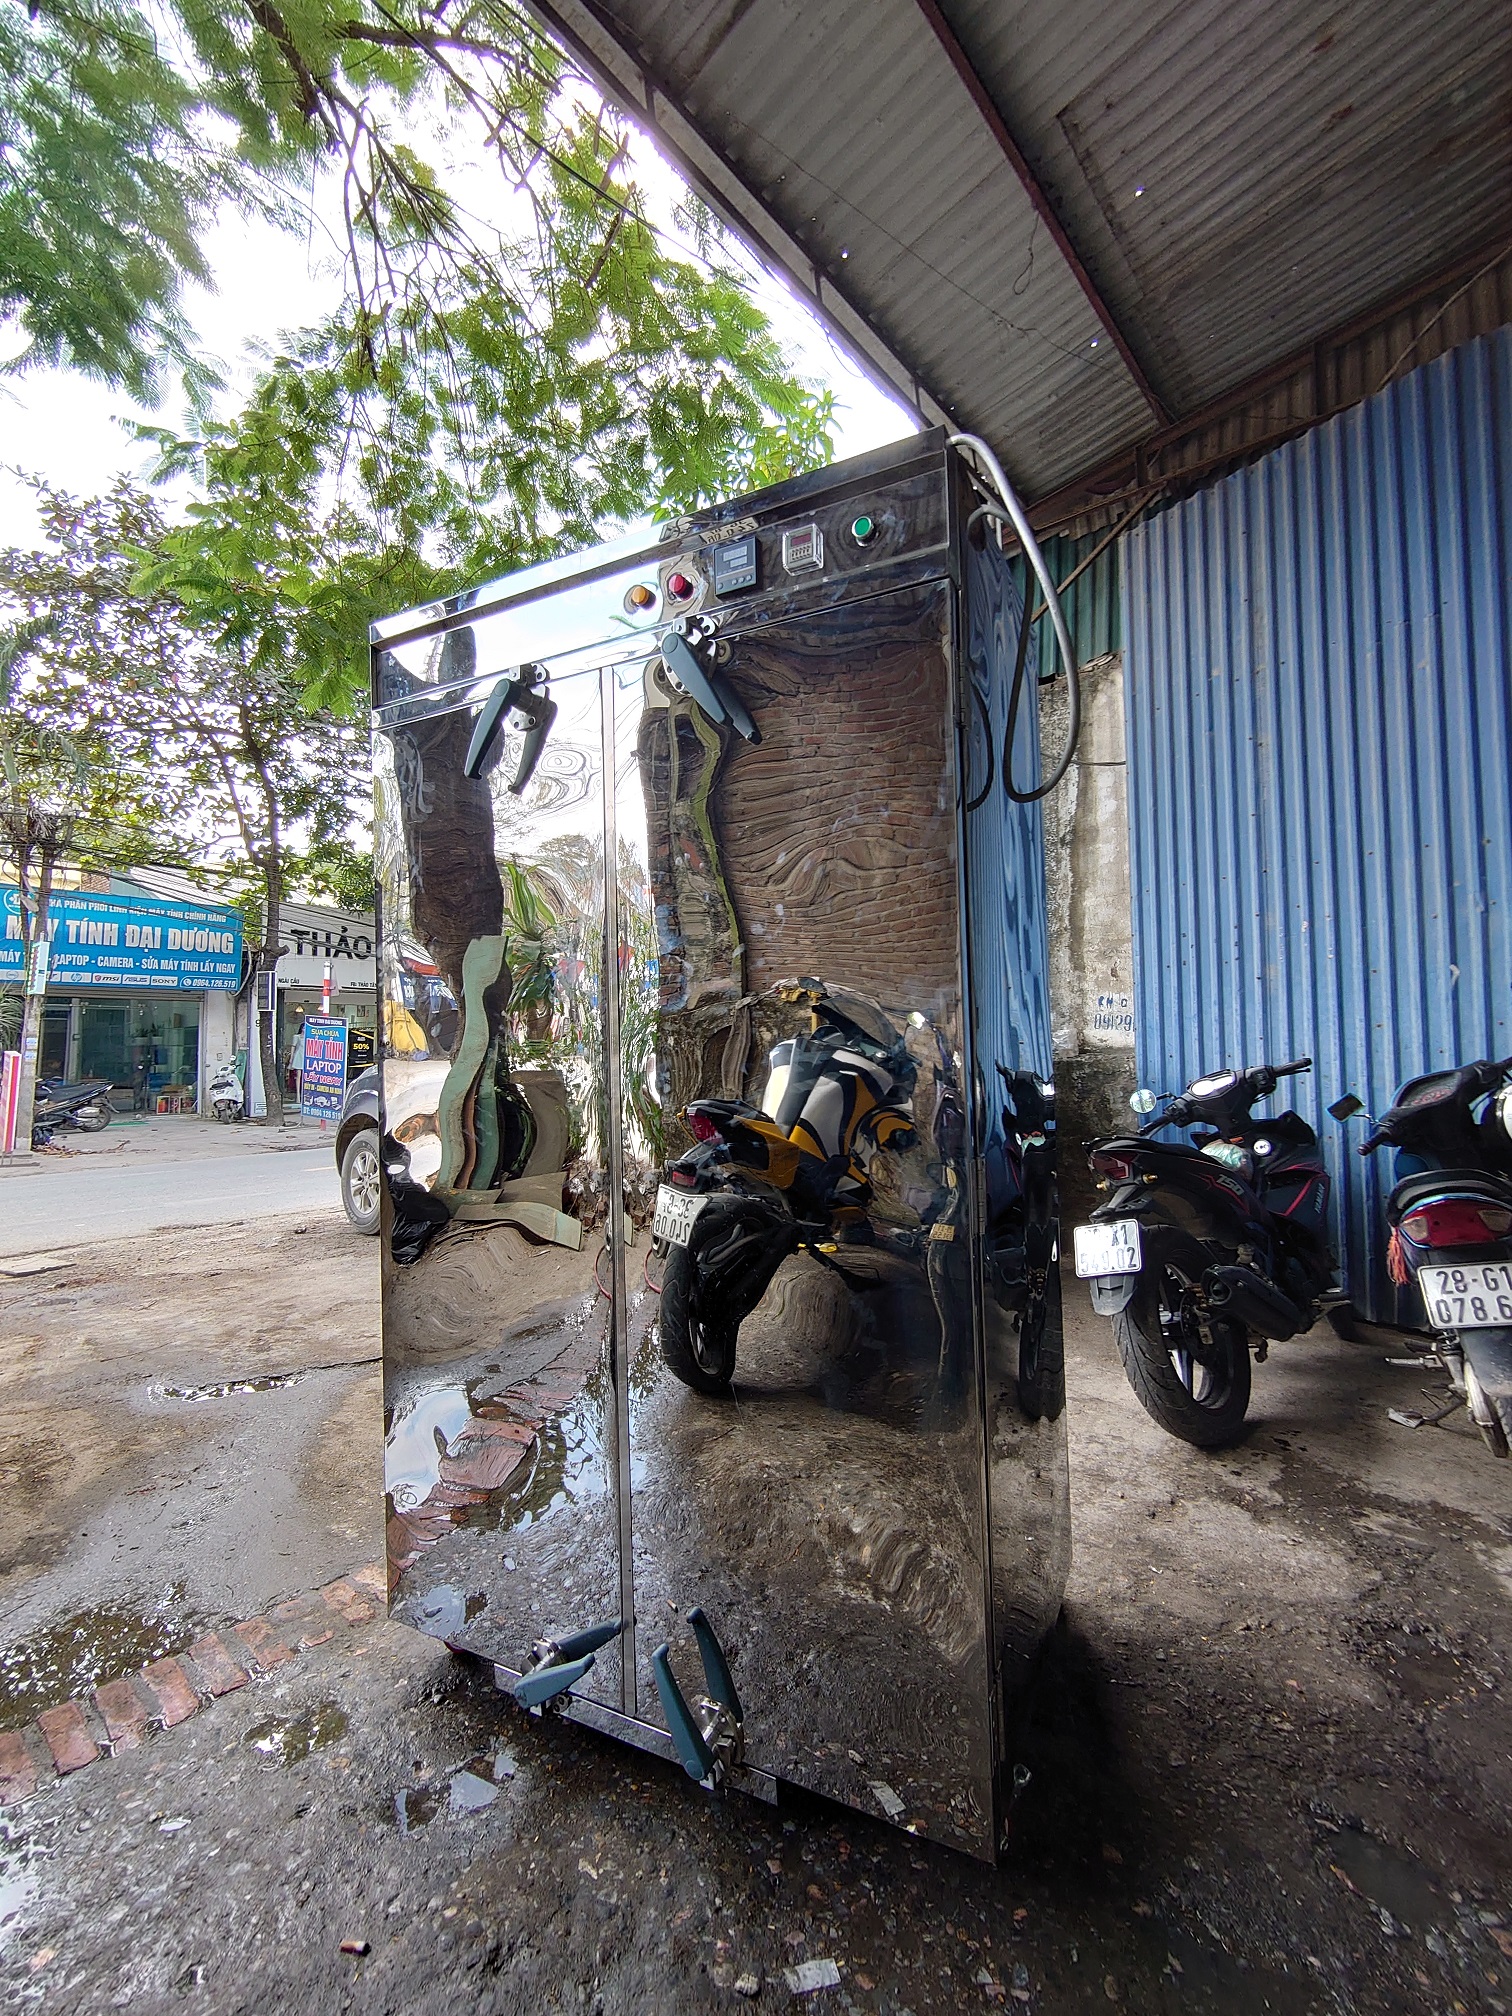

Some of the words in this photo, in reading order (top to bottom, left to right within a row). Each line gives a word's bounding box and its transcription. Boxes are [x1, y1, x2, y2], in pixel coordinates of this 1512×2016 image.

[49, 897, 62, 908] HÀ
[66, 917, 119, 946] TÍNH
[125, 924, 162, 953] ĐẠI
[167, 926, 234, 954] DƯƠNG
[290, 925, 371, 960] THẢO
[0, 949, 21, 963] MÁY
[97, 956, 134, 968] CAMERA
[141, 955, 159, 970] SỬA
[160, 958, 179, 971] MÁY
[180, 959, 199, 972] TÍNH
[200, 959, 214, 973] LẤY
[216, 963, 236, 974] NGAY
[306, 1036, 324, 1058] MÁY
[325, 1037, 344, 1061] TÍNH
[306, 1060, 342, 1074] LAPTOP
[320, 1075, 343, 1086] NGAY
